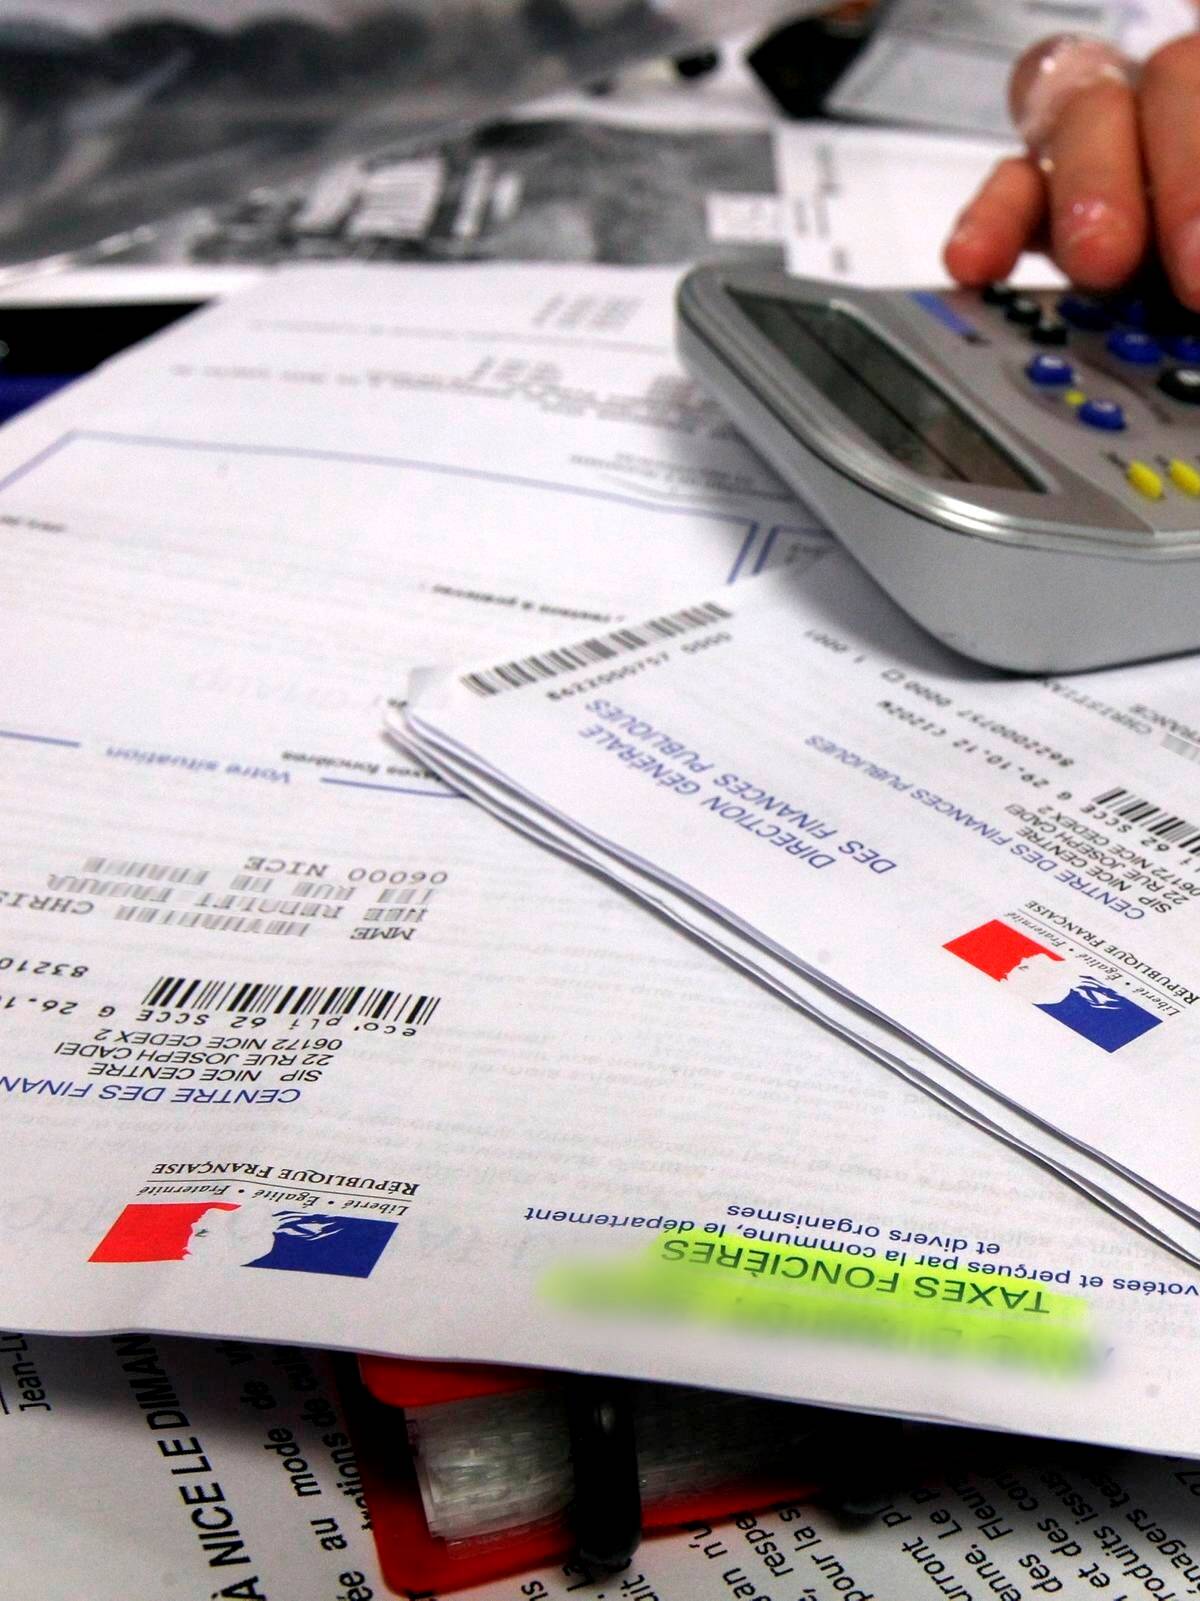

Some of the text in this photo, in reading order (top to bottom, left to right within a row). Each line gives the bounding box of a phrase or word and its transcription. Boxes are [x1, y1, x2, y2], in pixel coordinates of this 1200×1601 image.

[578, 724, 837, 870] DIRECTION GÉNÉRALE
[584, 699, 898, 875] DES FINANCES PUBLIQUES
[1036, 804, 1055, 816] 2
[1079, 803, 1133, 834] SCCE
[804, 735, 1146, 921] CENTRE DES FINANCES PUBLIQUES
[1049, 811, 1111, 847] CEDEX
[243, 856, 329, 879] NICE
[1004, 803, 1190, 906] 22 RUE JOSEPH CADEI
[1016, 826, 1173, 914] SIP NICE CENTRE
[1107, 844, 1154, 870] NICE
[1003, 911, 1181, 1017] Liberté Égalité Fraternité
[1024, 900, 1200, 1006] RÉPUBLIQUE FRANÇAISE
[0, 995, 79, 1016] 26.1
[97, 1005, 116, 1018] G
[135, 1008, 210, 1026] SCCE
[229, 1015, 267, 1029] 62
[53, 1041, 335, 1067] 22 RUE JOSEPH CADEI
[93, 1027, 344, 1051] 06172 NICE CEDEX 2
[0, 1075, 302, 1104] CENTRE DES FINAN
[87, 1061, 323, 1083] SIP NICE CENTRE
[151, 1160, 420, 1197] RÉPUBLIQUE FRANÇAISE
[136, 1184, 410, 1217] Liberté Égalité Fraternité
[726, 1204, 1001, 1255] et divers organismes
[523, 1207, 1200, 1297] votées et perçues par la commune, le département
[663, 1239, 1050, 1314] TAXES FONCIÈRES
[157, 1436, 212, 1476] LE
[265, 1427, 322, 1498] mode
[178, 1482, 252, 1568] NICE
[310, 1517, 348, 1552] au
[793, 1525, 822, 1552] la
[929, 1508, 963, 1540] Le
[1036, 1517, 1111, 1589] et des
[211, 1575, 267, 1601] À
[1018, 1553, 1064, 1594] des
